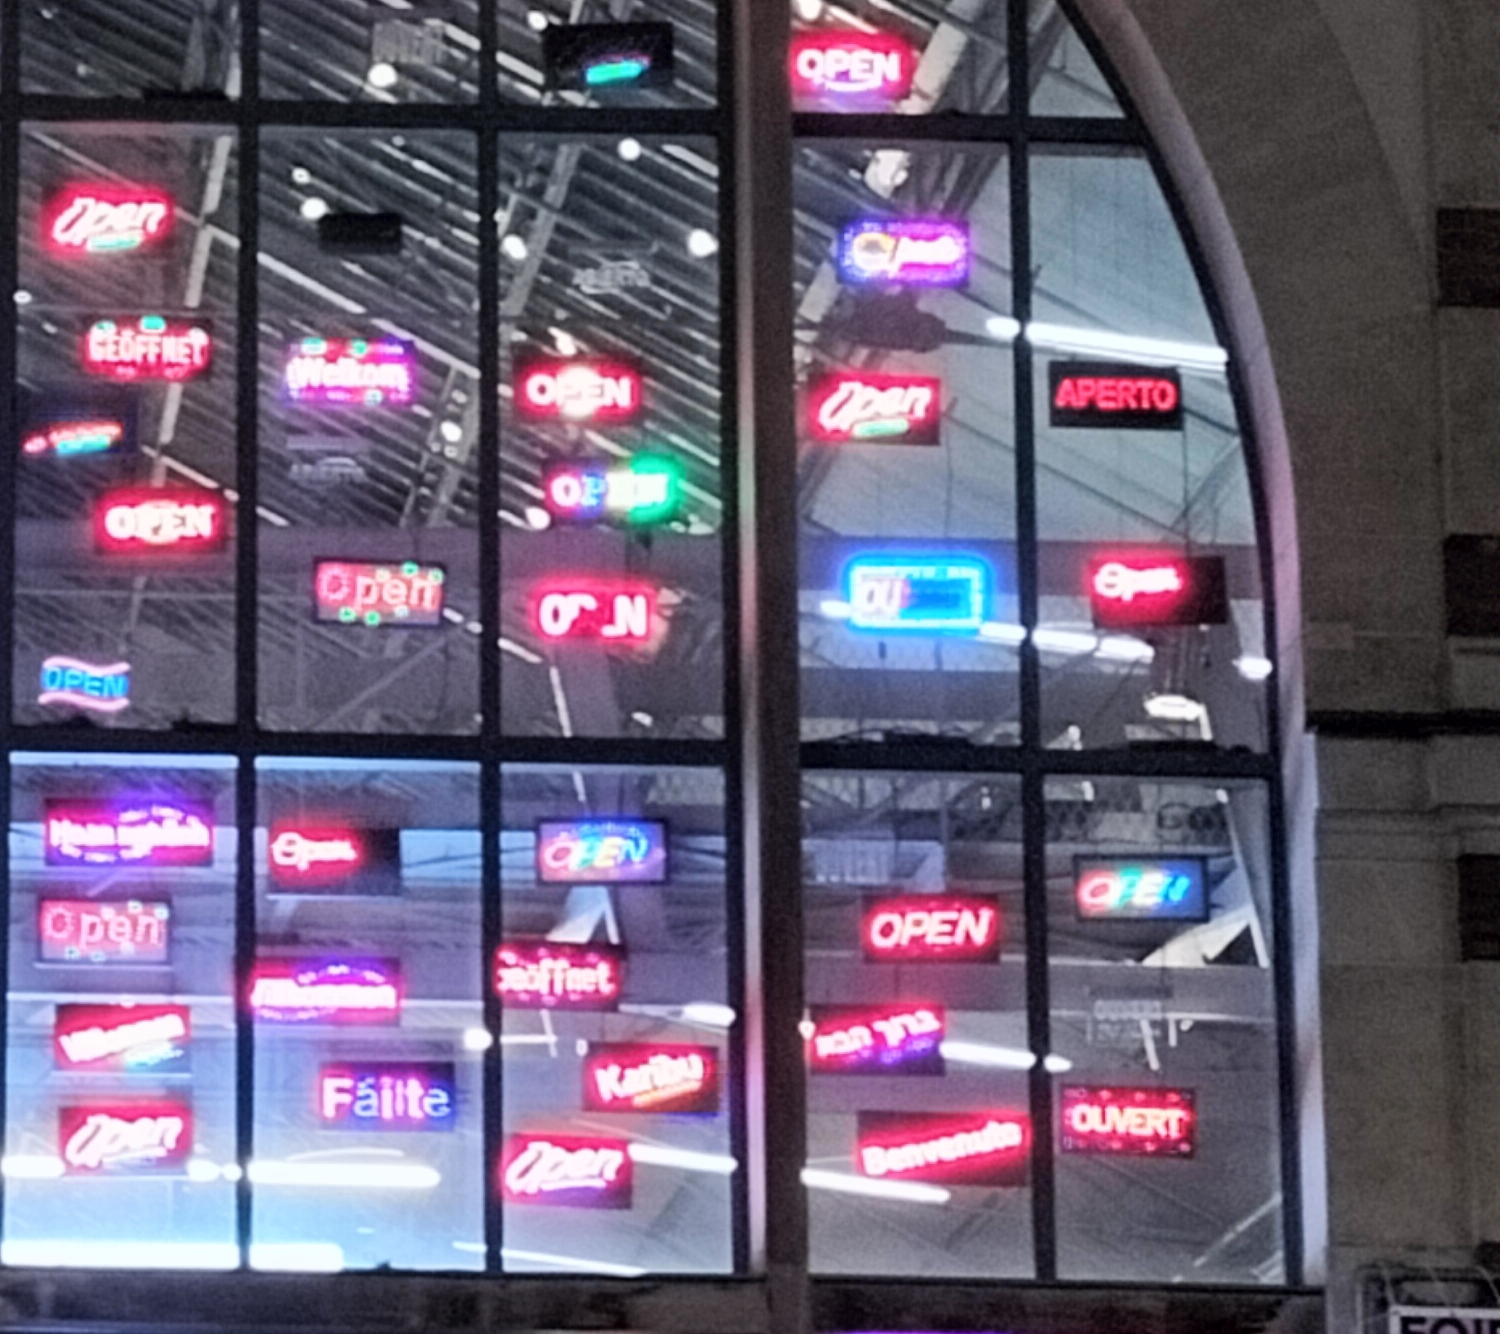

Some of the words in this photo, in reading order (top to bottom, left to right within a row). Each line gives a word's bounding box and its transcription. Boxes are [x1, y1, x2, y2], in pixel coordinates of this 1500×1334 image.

[795, 47, 902, 82] OPEN
[53, 197, 165, 245] Open
[526, 372, 632, 409] OPEN
[818, 380, 932, 431] Open
[1055, 376, 1177, 411] APERTO
[105, 504, 215, 540] OPEN
[319, 569, 436, 609] Open
[41, 665, 129, 698] OPEN
[542, 833, 648, 870] OPEN
[1080, 868, 1191, 906] OPEN
[44, 907, 161, 945] Open
[869, 909, 994, 948] OPEN
[1072, 1105, 1188, 1138] OUVERT
[65, 1115, 182, 1167] Open
[504, 1142, 625, 1194] Open
